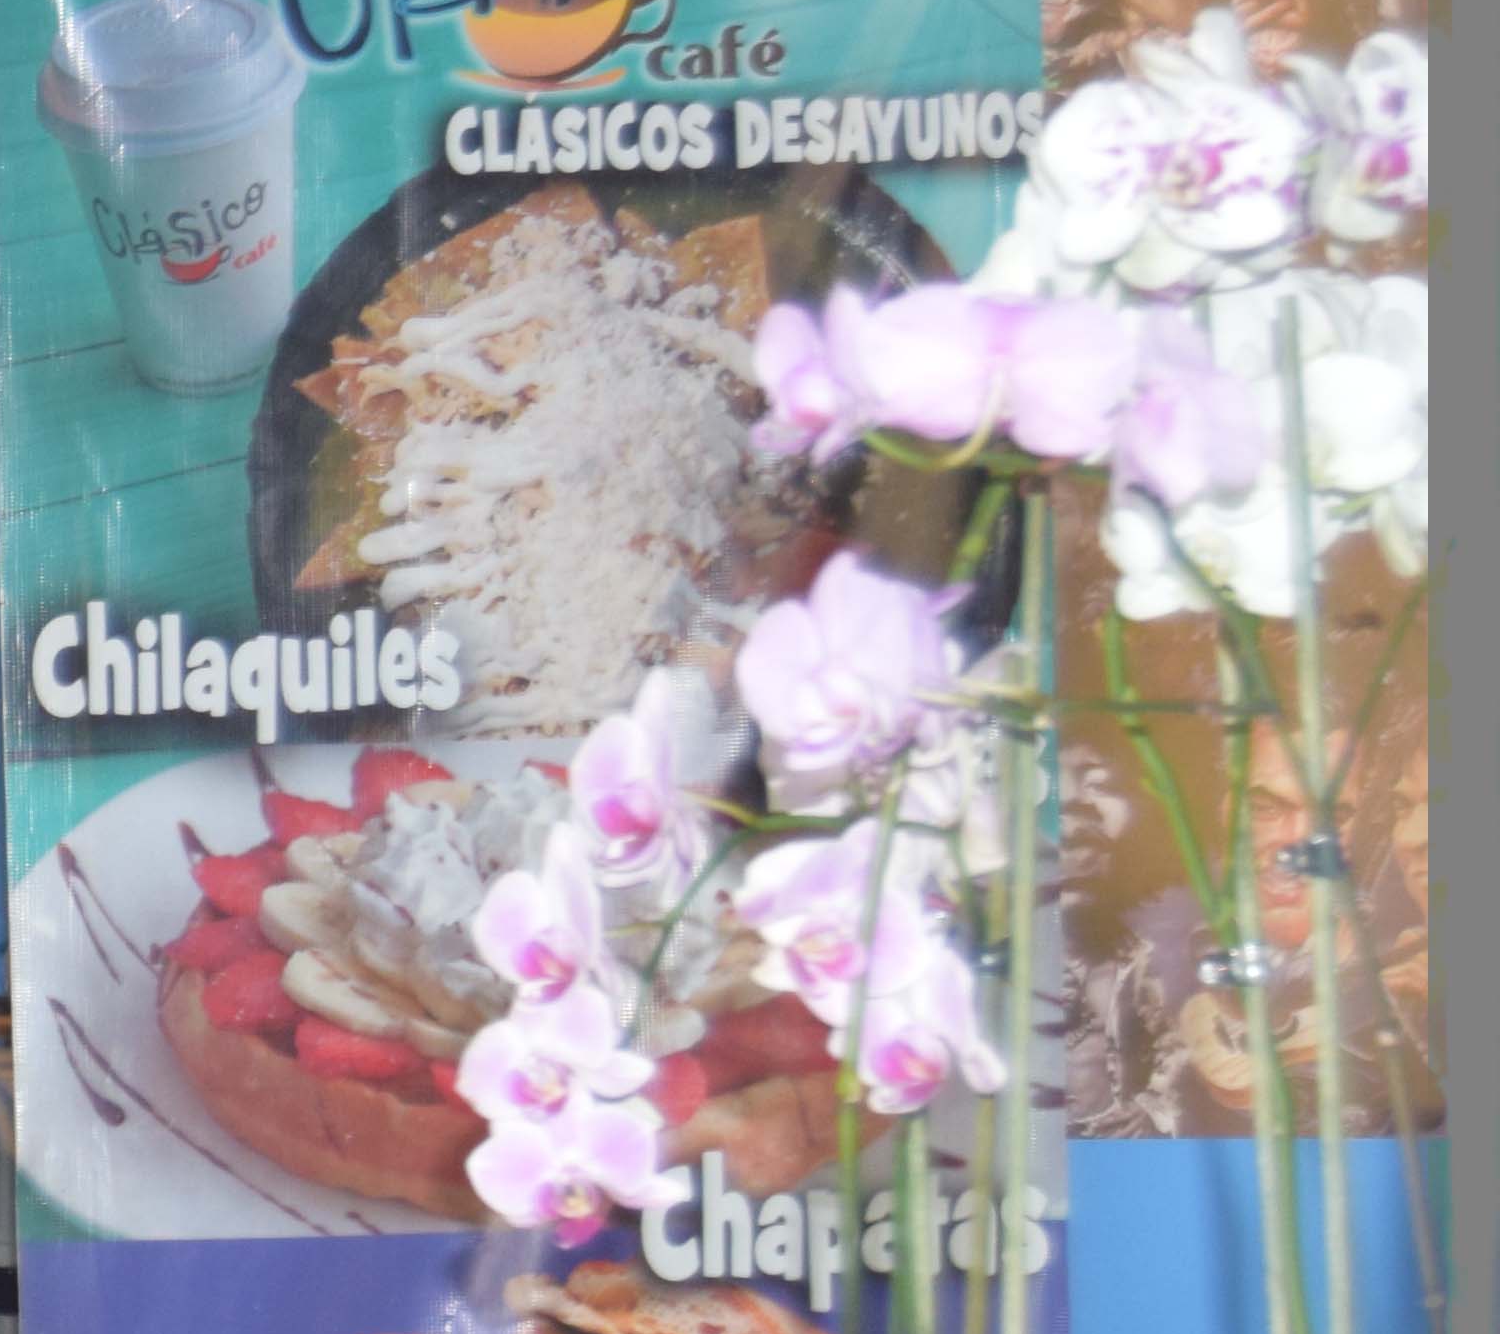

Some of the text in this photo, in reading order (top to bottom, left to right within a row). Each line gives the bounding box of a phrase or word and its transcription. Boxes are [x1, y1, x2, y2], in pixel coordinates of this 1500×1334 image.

[646, 24, 787, 82] café
[446, 90, 1043, 178] CLÁSICOS DESAYUNOS
[31, 599, 462, 746] Chilaquiles
